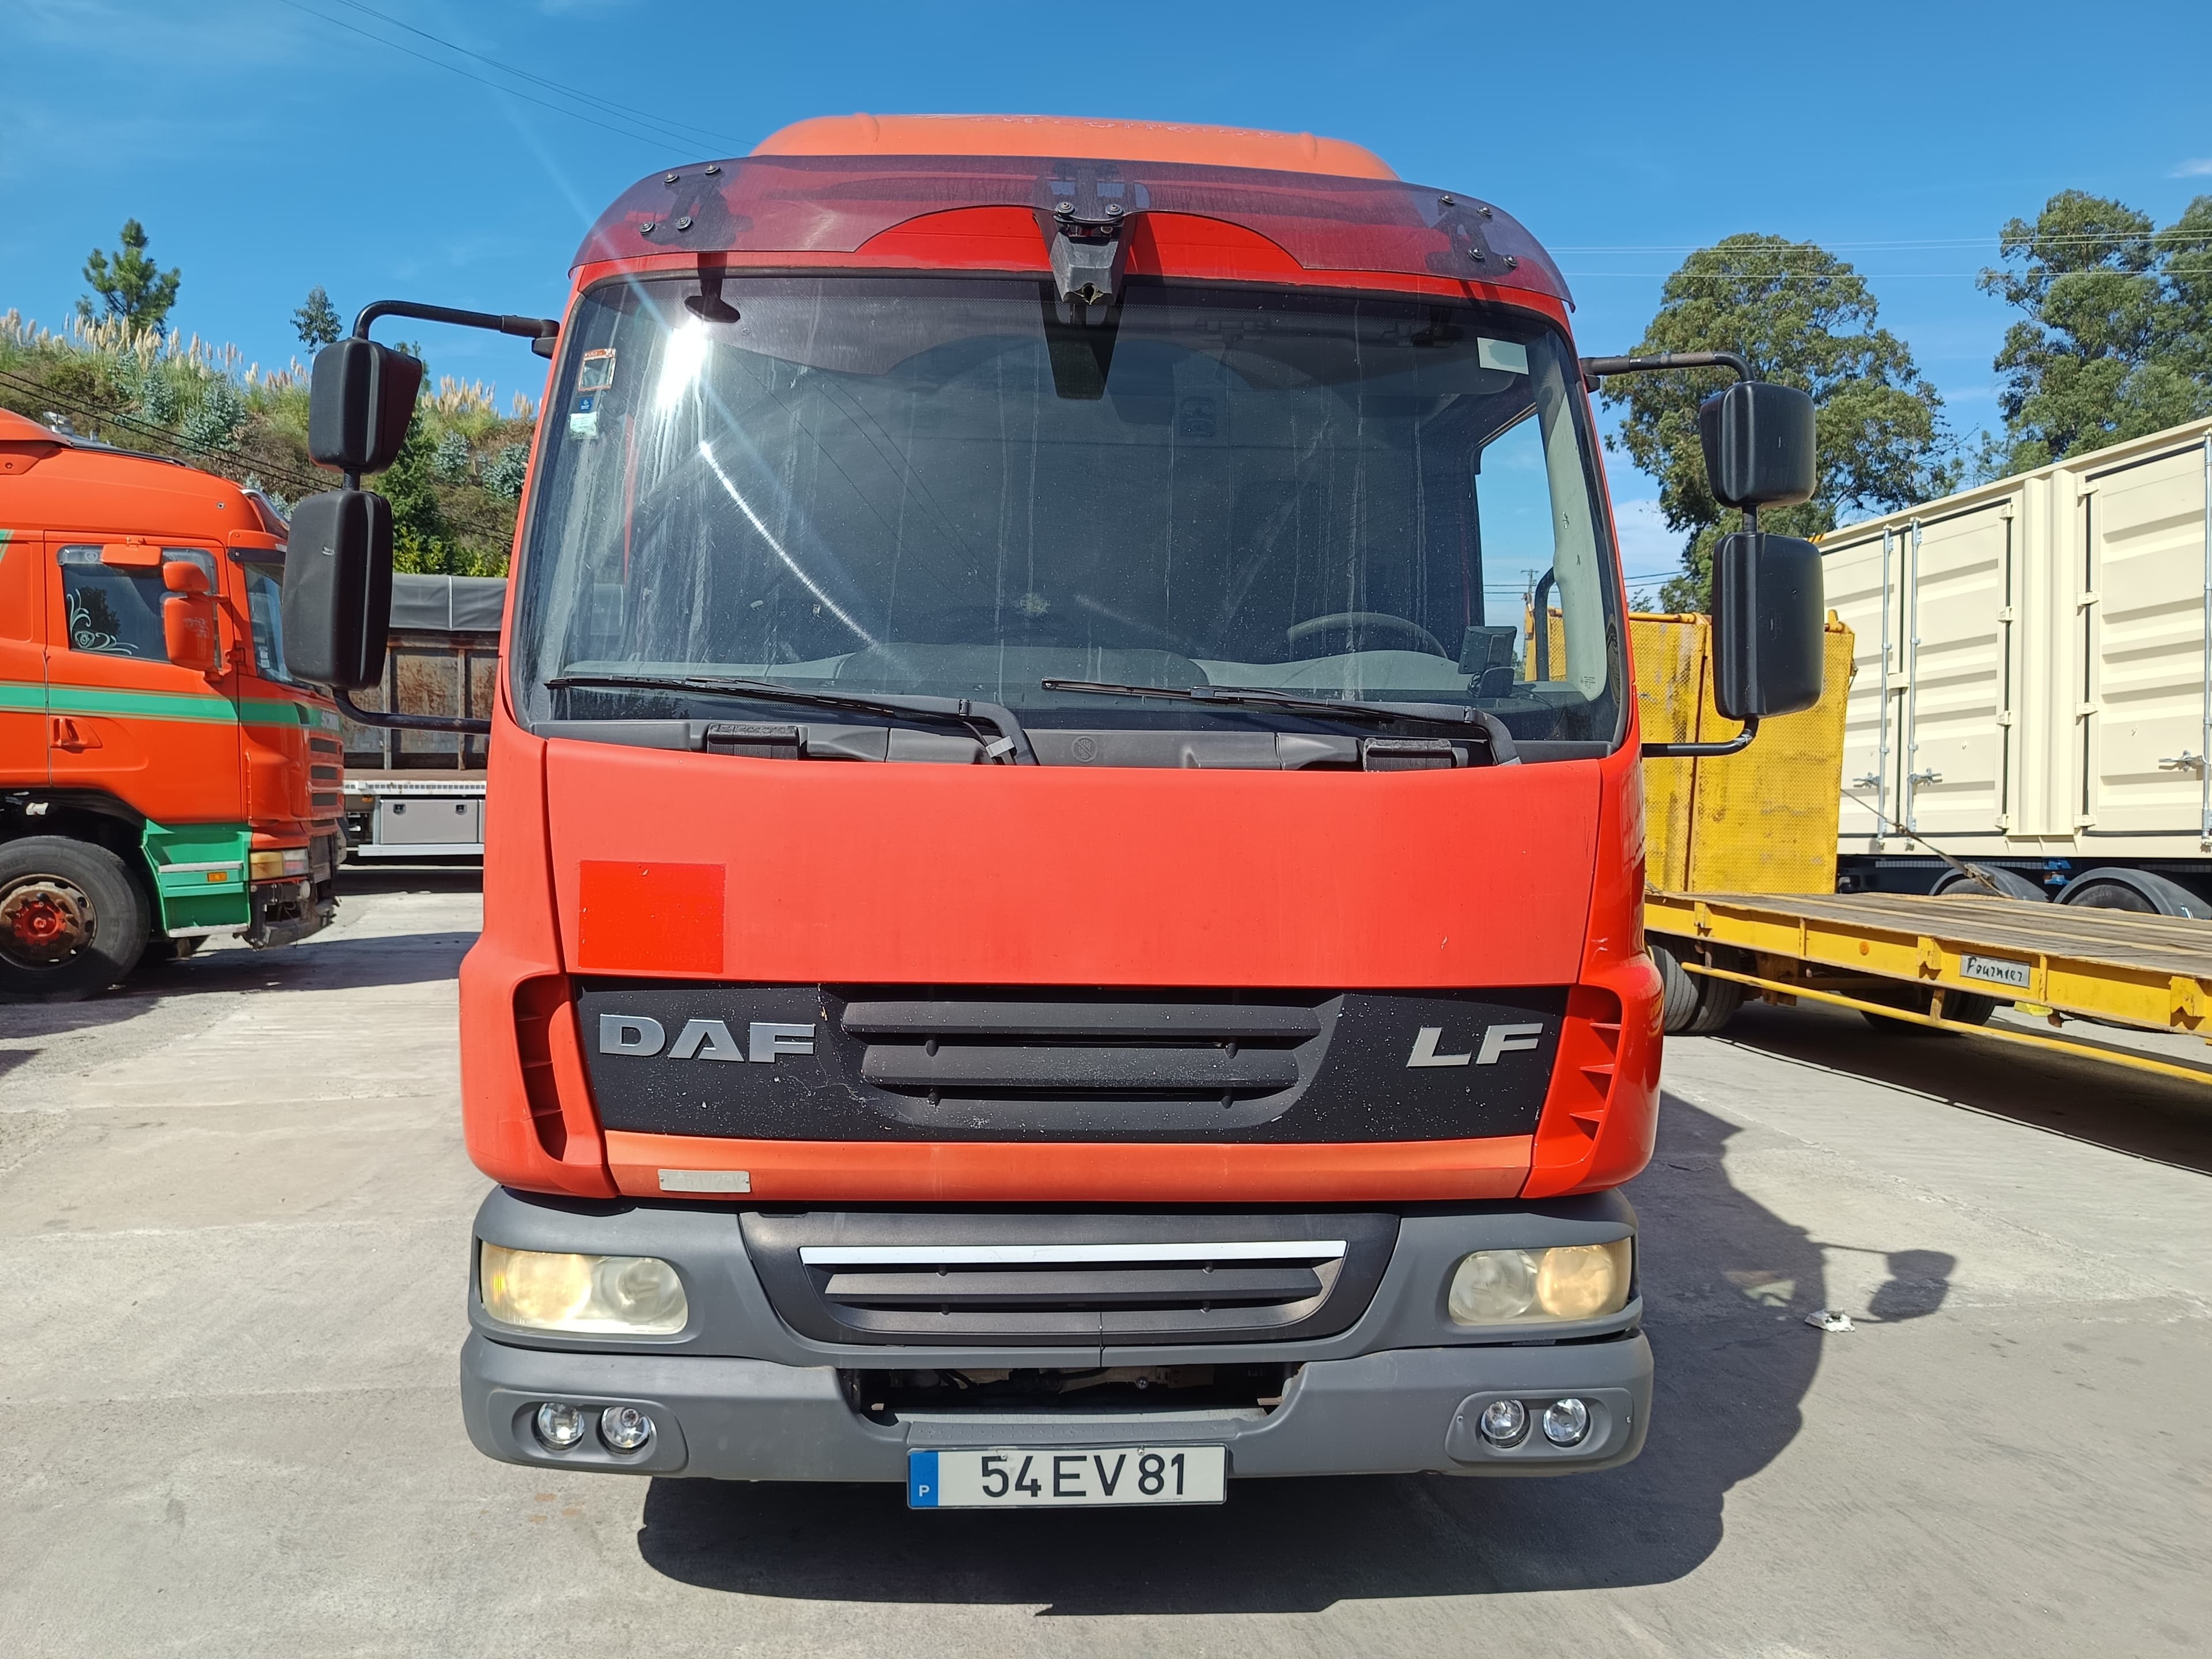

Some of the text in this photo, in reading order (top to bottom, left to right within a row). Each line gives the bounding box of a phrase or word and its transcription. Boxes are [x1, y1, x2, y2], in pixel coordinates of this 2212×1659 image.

[1967, 956, 2022, 982] Fournier
[600, 1013, 816, 1063] DAF
[1406, 1022, 1543, 1067] LF
[919, 1484, 930, 1497] P
